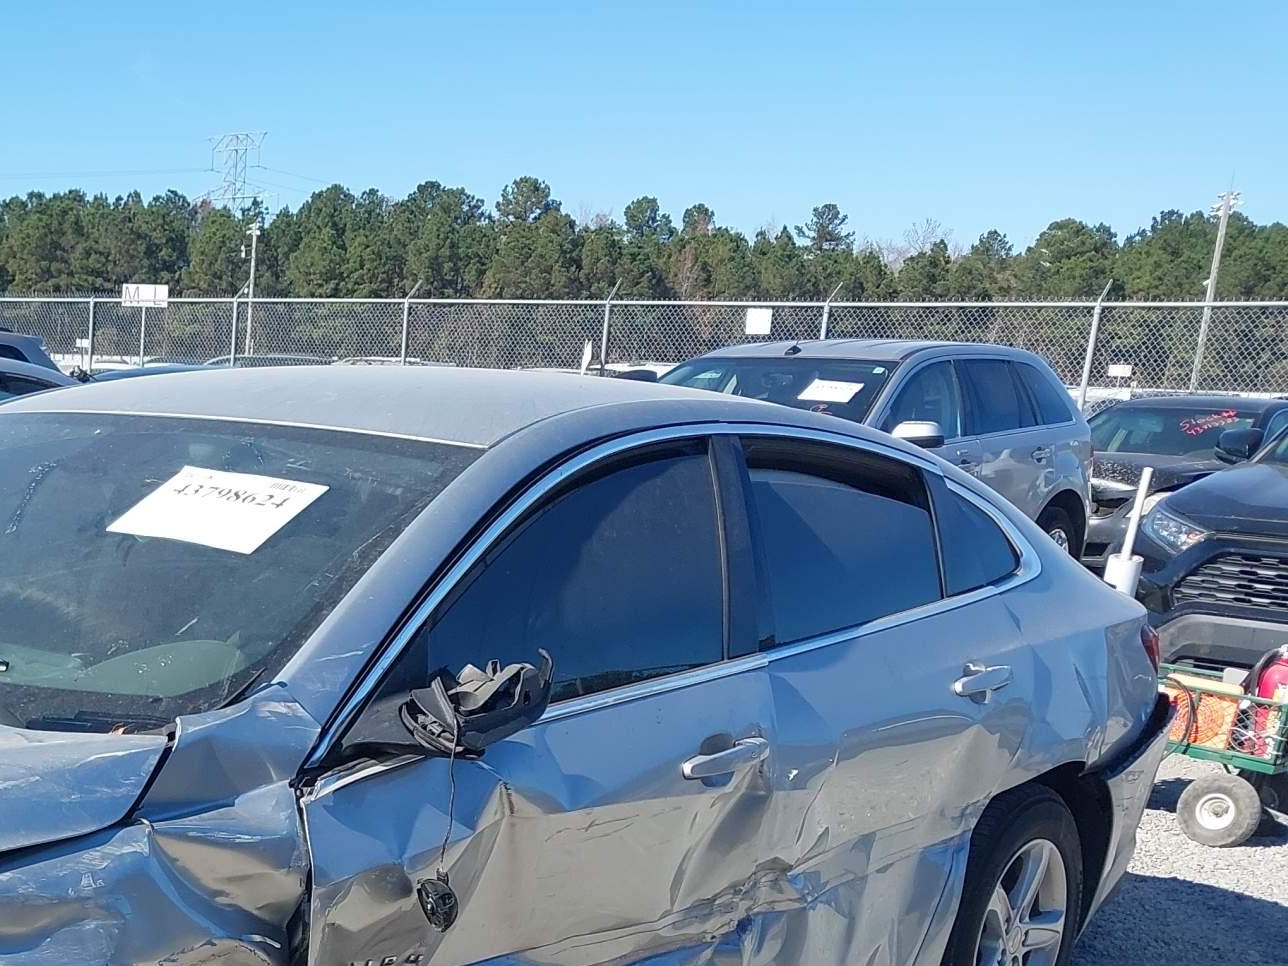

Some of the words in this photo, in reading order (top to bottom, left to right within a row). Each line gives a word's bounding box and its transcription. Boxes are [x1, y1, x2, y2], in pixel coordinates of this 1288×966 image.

[124, 286, 140, 305] M
[153, 286, 163, 305] L
[173, 483, 291, 509] 43798624
